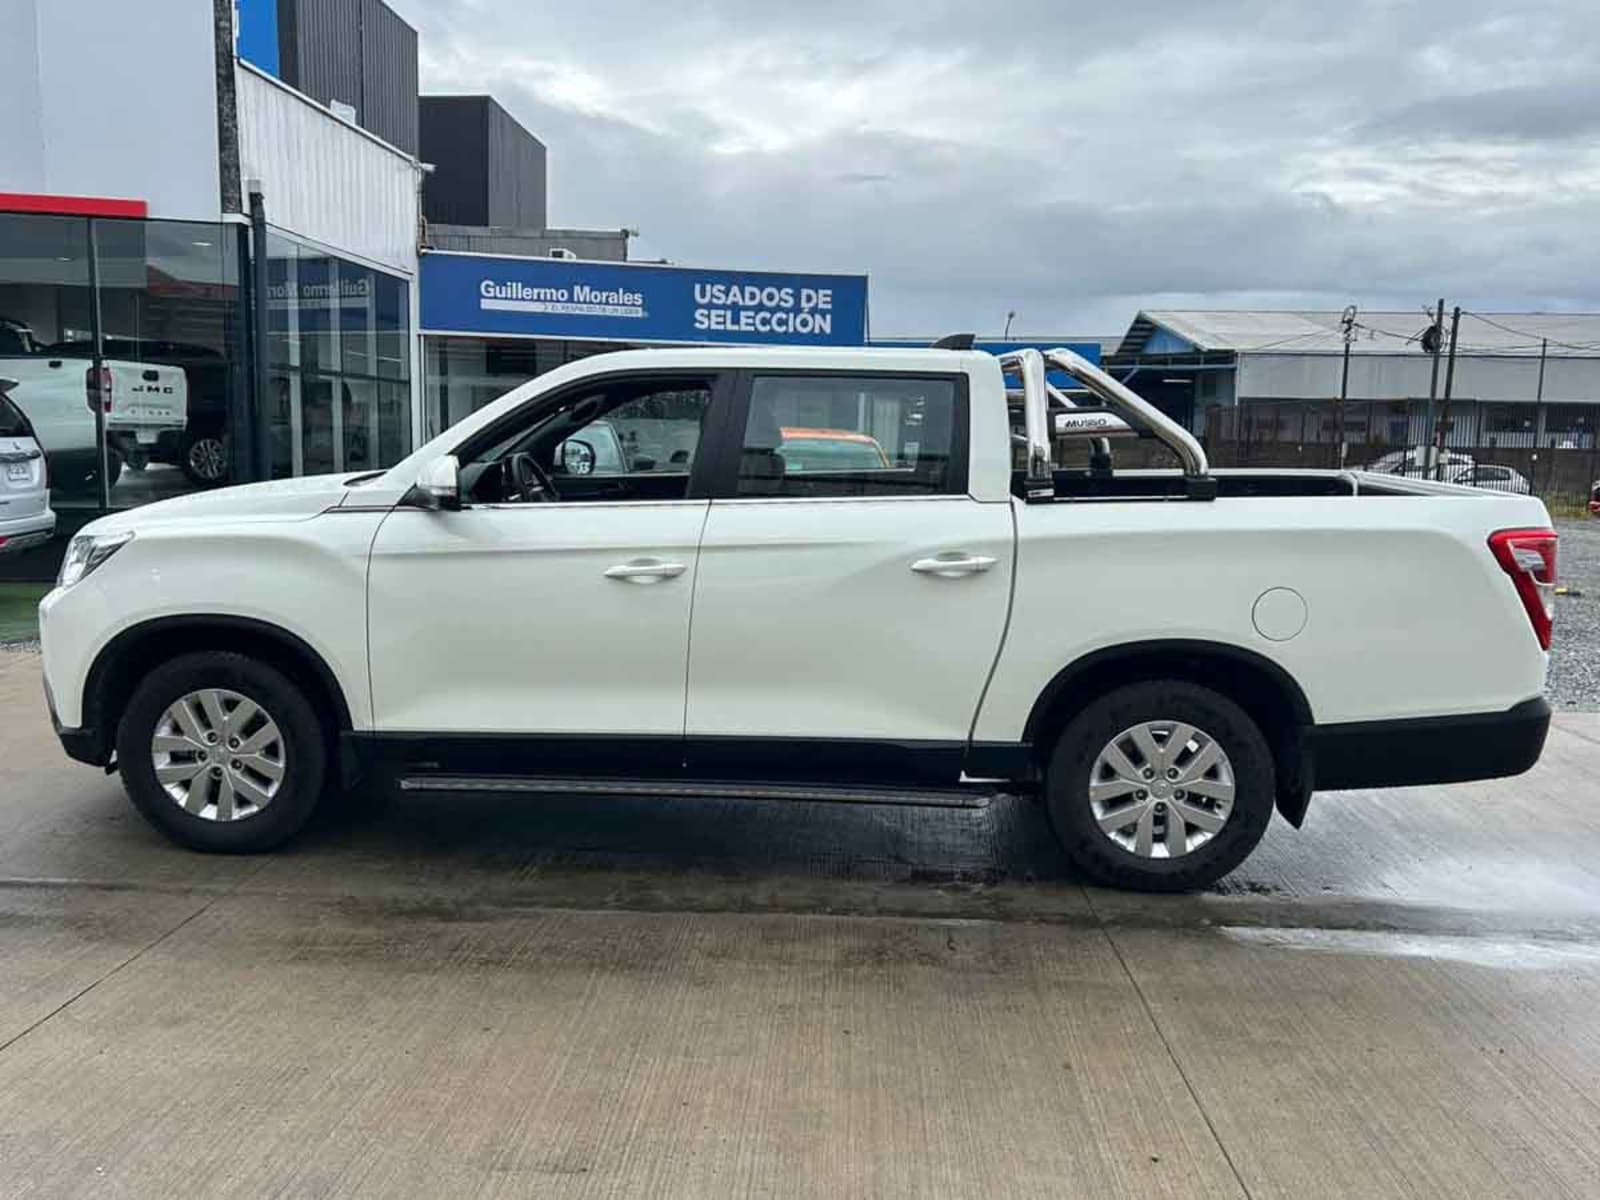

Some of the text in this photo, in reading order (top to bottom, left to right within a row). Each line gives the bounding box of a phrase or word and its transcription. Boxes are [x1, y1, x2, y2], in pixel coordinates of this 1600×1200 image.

[480, 279, 643, 305] Guillermo Morales
[694, 283, 832, 309] USADOS DE
[694, 307, 832, 334] SELECCIÓN
[132, 385, 173, 394] JMC
